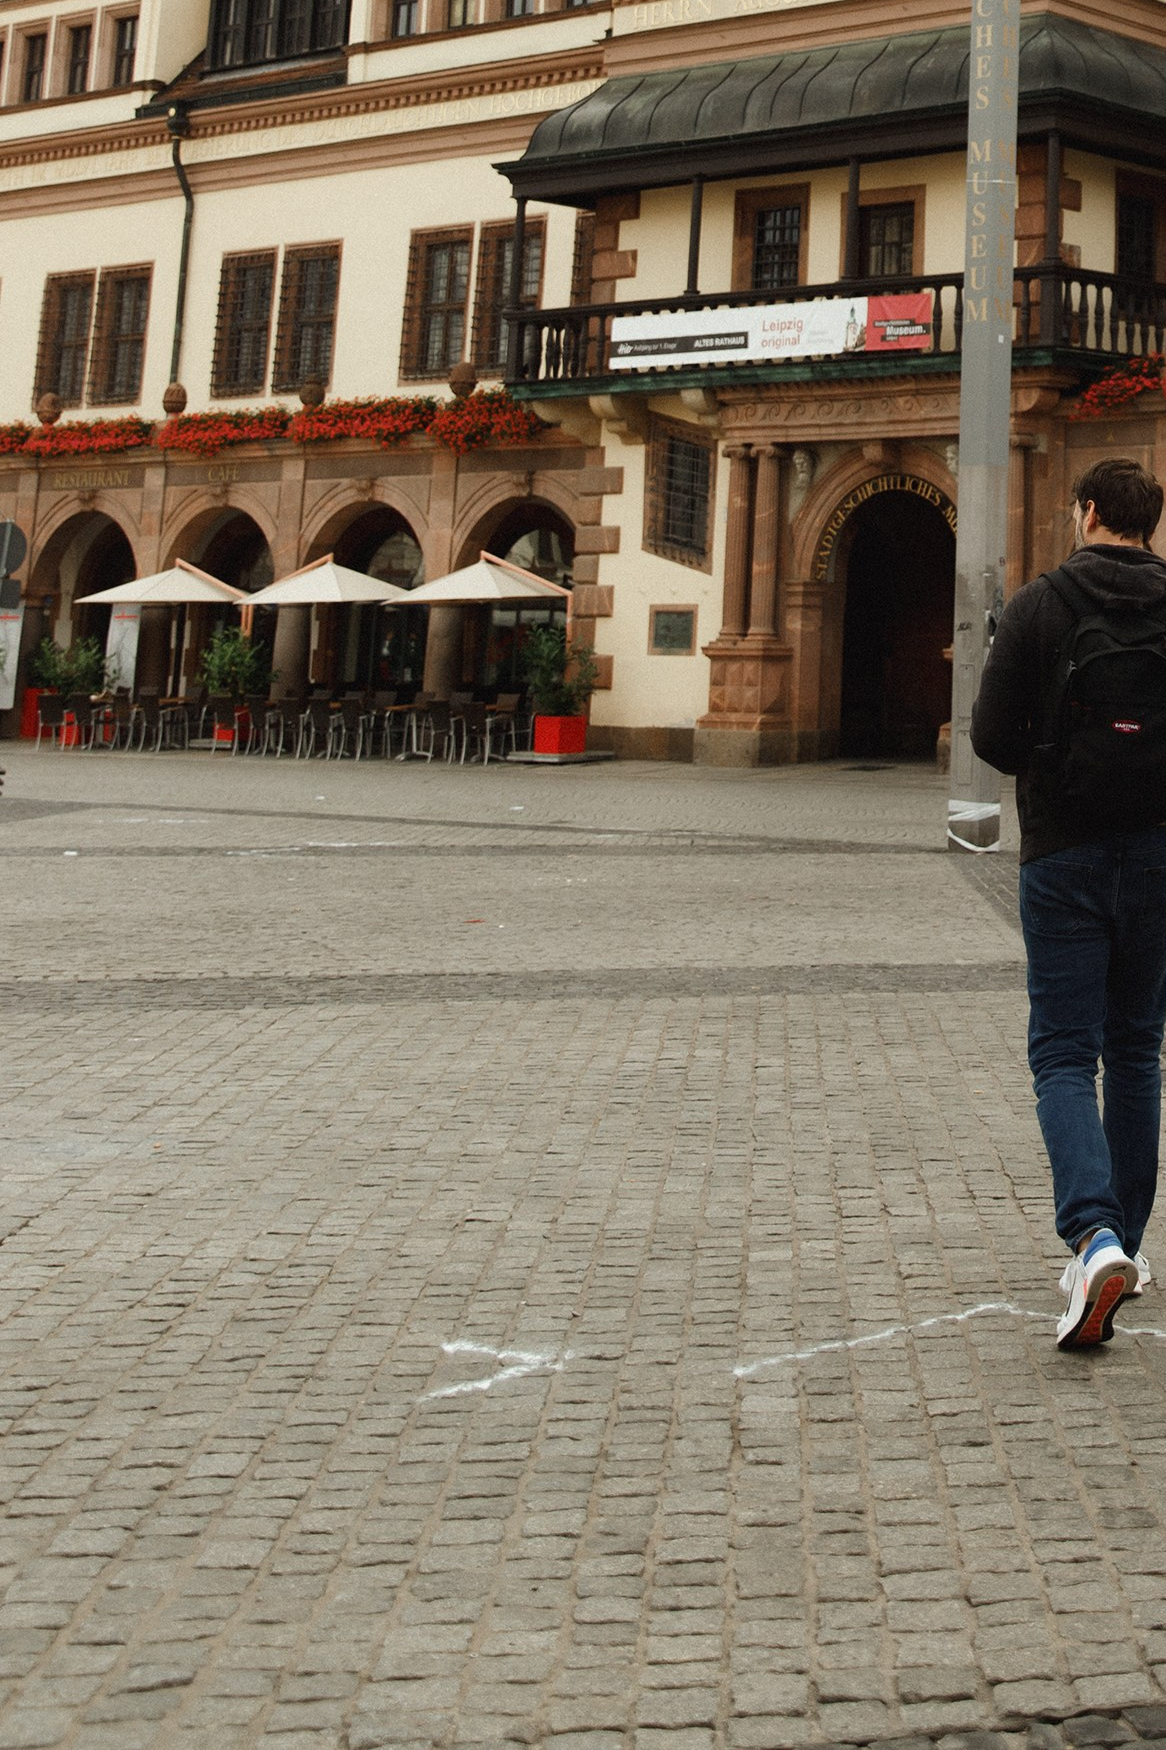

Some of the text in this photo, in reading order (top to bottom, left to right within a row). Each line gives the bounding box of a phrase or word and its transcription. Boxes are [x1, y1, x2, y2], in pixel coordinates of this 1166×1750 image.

[966, 139, 992, 323] MUSEUM
[762, 317, 804, 333] Leipzig
[693, 337, 714, 349] ALTES
[715, 335, 745, 347] RATHAUS
[761, 334, 801, 349] original
[53, 469, 129, 488] RESTAURANT
[815, 475, 941, 580] STADTGESCHICHTLICHES
[1114, 722, 1139, 730] EASTPAK
